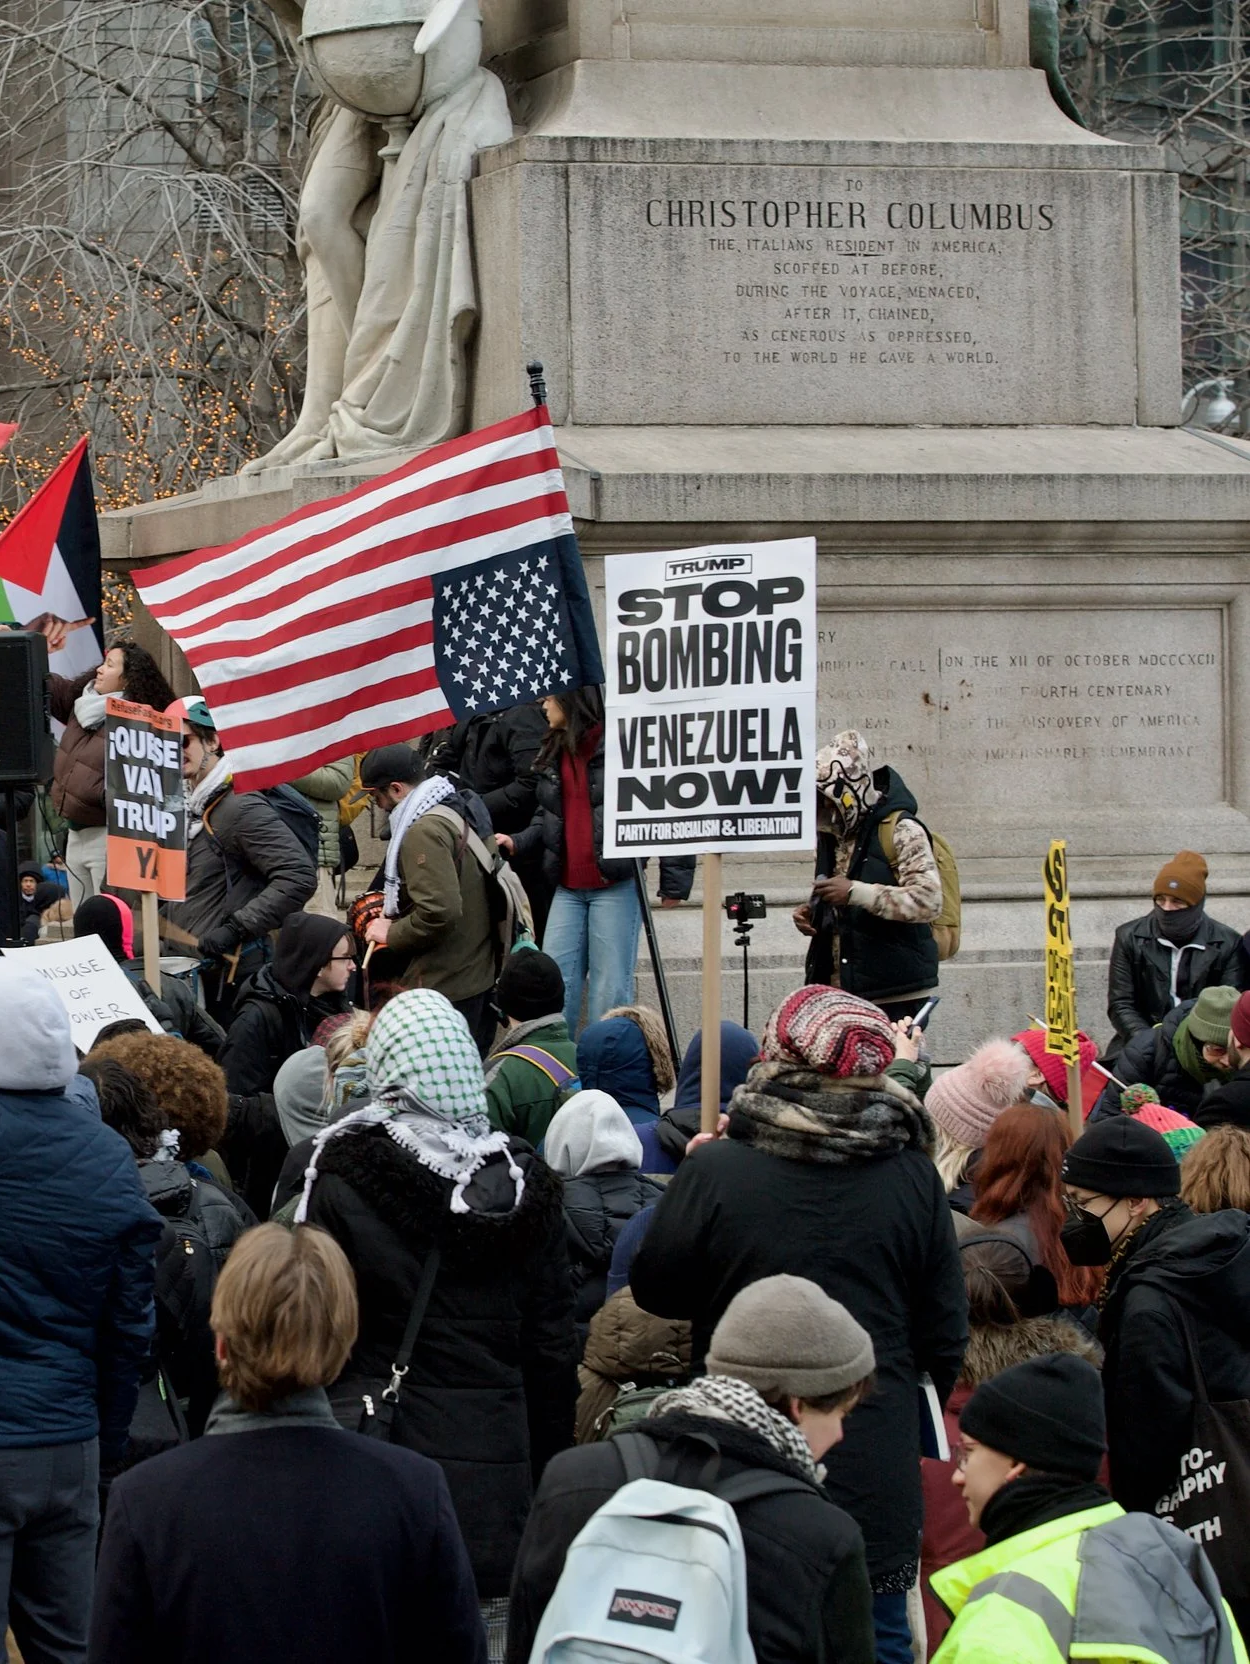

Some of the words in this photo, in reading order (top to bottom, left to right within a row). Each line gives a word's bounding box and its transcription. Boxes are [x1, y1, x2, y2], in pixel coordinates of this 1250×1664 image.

[646, 200, 866, 229] CHRISTOPHER
[887, 202, 1054, 231] COLUMBUS
[708, 238, 736, 251] THE
[746, 239, 813, 251] ITALIANS
[826, 239, 895, 252] RESIDENT
[907, 240, 920, 252] IN
[932, 240, 1002, 255] AMERICA,
[773, 262, 840, 275] SCOFFED
[851, 263, 869, 275] AT
[881, 263, 943, 278] BEFORE,
[736, 285, 789, 298] DURING
[801, 285, 828, 298] THE
[908, 286, 980, 300] MENACED,
[784, 307, 831, 320] AFTER
[868, 308, 934, 324] CHAINED,
[741, 330, 759, 342] AS
[771, 330, 846, 342] GENEROUS
[887, 331, 976, 346] OPPRESSED,
[723, 351, 741, 363] TO
[754, 351, 780, 363] THE
[790, 352, 838, 364] WORLD
[849, 352, 867, 364] HE
[878, 352, 915, 364] GAVE
[927, 352, 935, 364] A
[945, 352, 999, 364] WORLD.
[669, 558, 745, 576] TRUMP
[617, 576, 805, 627] STOP
[617, 618, 803, 695] BOMBING
[944, 655, 963, 668] ON
[973, 655, 999, 668] THE
[1009, 655, 1028, 667] XII
[1037, 655, 1055, 667] OF
[1064, 653, 1130, 667] OCTOBER
[1087, 684, 1172, 698] CENTENARY
[617, 706, 803, 770] VENEZUELA
[617, 767, 803, 812] NOW!
[618, 823, 650, 842] PARTY
[651, 822, 672, 840] FOR
[673, 819, 720, 839] SOCIALISM
[721, 819, 737, 836] &
[737, 816, 799, 836] LIBERATION
[36, 958, 106, 981] MISUSE
[69, 986, 92, 1000] OF
[71, 1002, 130, 1025] OWER
